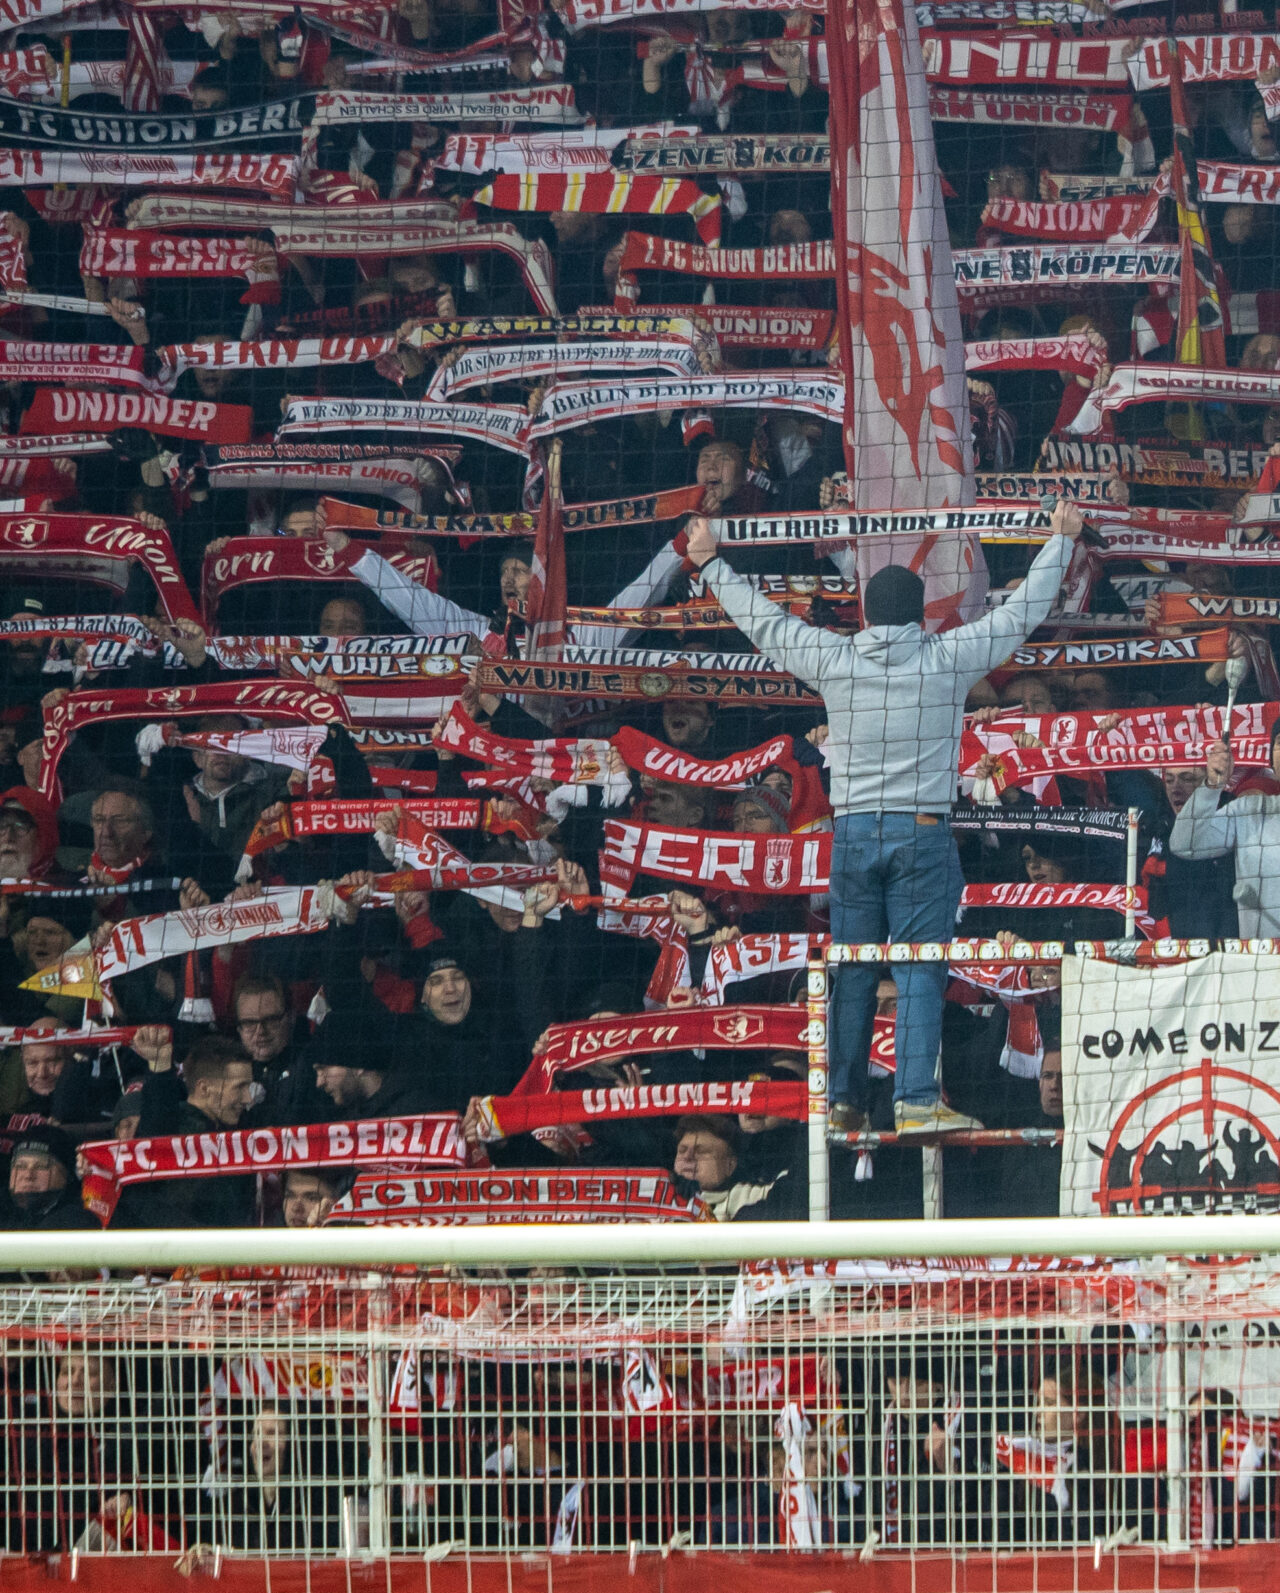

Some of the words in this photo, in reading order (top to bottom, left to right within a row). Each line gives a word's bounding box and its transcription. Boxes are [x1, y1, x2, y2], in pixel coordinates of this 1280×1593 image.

[424, 104, 455, 116] WIRD
[512, 104, 540, 116] UND
[986, 103, 1110, 126] UNION
[73, 117, 195, 143] UNION
[991, 201, 1111, 231] UNION
[693, 246, 757, 272] UNION
[763, 241, 838, 273] BERLIN
[713, 317, 813, 336] UNION
[52, 392, 218, 432] UNIONER
[551, 386, 631, 415] BERLIN
[638, 383, 717, 398] BLEIBT
[726, 518, 837, 542] ULTRAS
[848, 513, 936, 536] UNION
[946, 510, 1052, 530] BERLIN
[290, 653, 418, 678] WUHLE
[493, 665, 624, 693] WUHLE
[644, 738, 785, 783] UNIONER
[1009, 749, 1036, 772] 1.
[1042, 745, 1082, 769] FC
[1088, 740, 1175, 766] Union
[294, 818, 309, 832] 1.
[312, 813, 338, 831] FC
[1082, 1026, 1188, 1060] COME
[1200, 1022, 1246, 1053] ON
[582, 1082, 754, 1114] UNIONER
[108, 1140, 158, 1174] FC
[171, 1126, 309, 1168] UNION
[328, 1119, 467, 1158] BERLIN
[352, 1182, 407, 1209] FC
[414, 1179, 541, 1205] UNION
[548, 1180, 697, 1212] BERLIN
